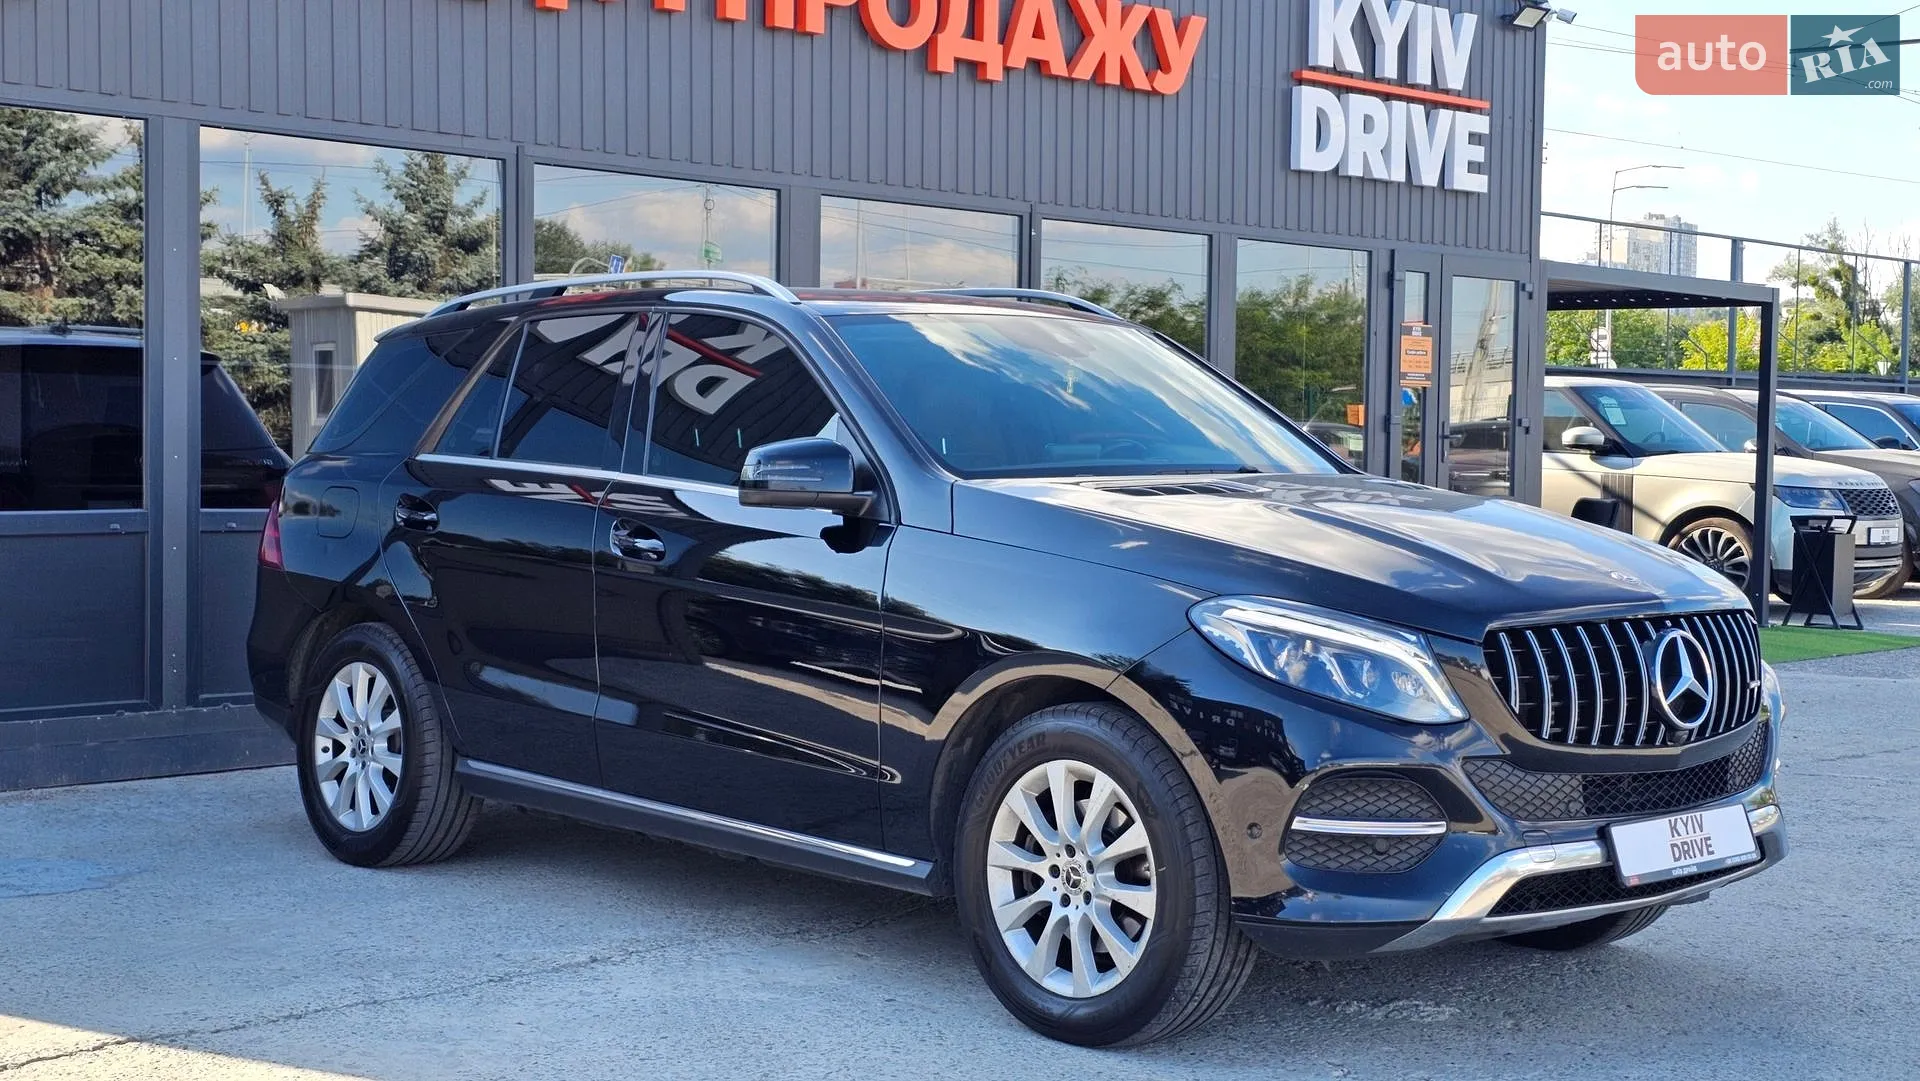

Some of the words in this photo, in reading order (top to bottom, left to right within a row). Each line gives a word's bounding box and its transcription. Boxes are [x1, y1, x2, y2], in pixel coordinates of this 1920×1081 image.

[1308, 0, 1478, 91] KYIV
[1290, 85, 1490, 193] DRIVE
[1668, 813, 1705, 839] KYIV
[1669, 836, 1715, 863] DRIVE
